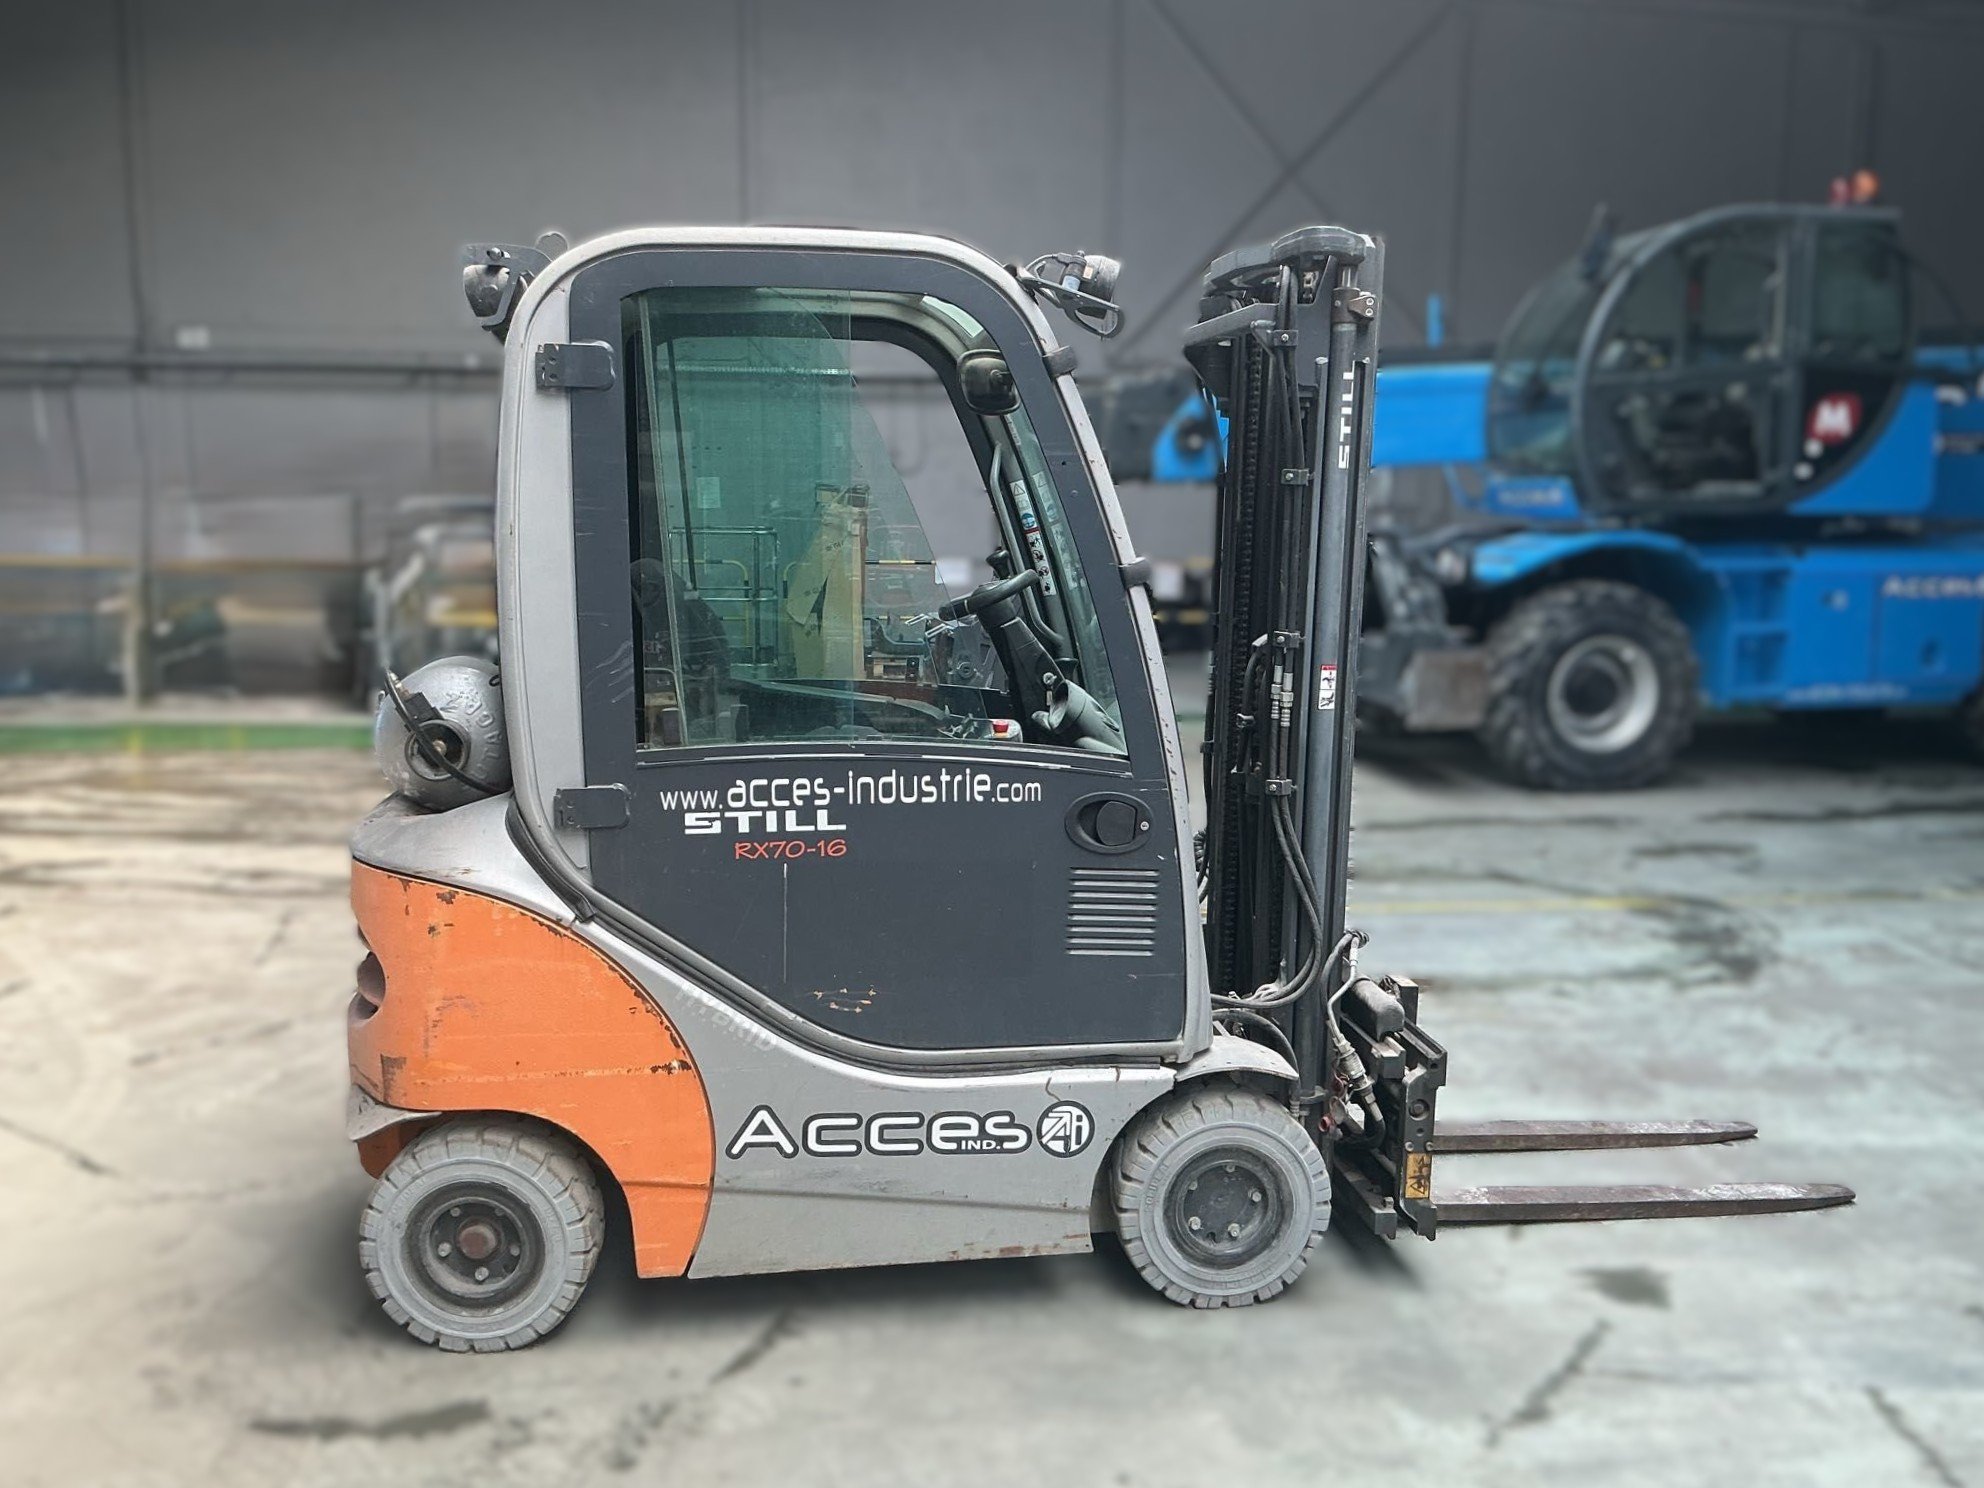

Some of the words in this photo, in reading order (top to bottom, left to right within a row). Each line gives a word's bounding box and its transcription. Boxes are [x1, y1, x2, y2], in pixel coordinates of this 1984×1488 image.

[1338, 361, 1355, 469] STILL
[660, 768, 1042, 810] www.acces-industrie.com
[684, 809, 847, 835] STILL
[734, 838, 847, 860] RX70-16
[960, 1140, 1002, 1151] IND.
